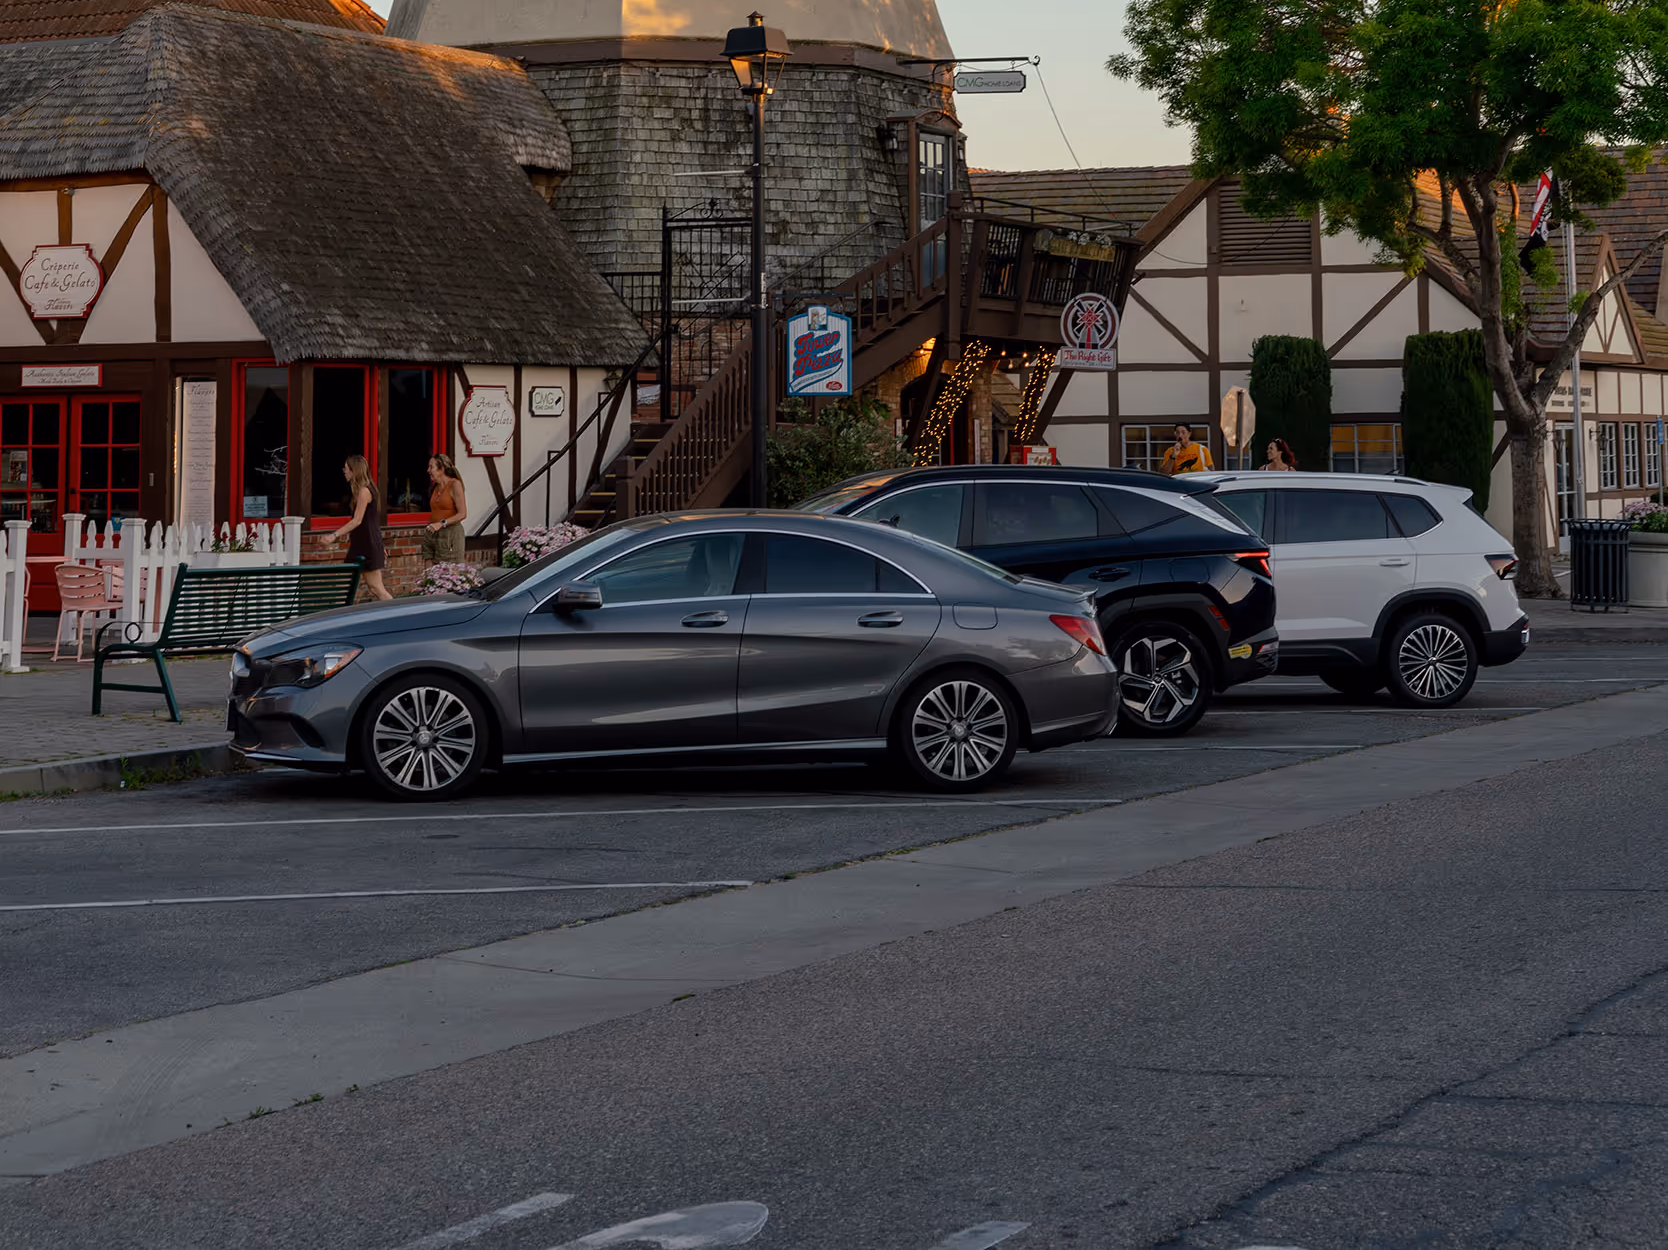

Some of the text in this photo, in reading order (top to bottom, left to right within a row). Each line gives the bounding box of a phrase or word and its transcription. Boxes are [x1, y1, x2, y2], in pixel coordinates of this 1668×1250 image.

[50, 277, 59, 288] &
[797, 332, 840, 355] Tower
[795, 351, 842, 377] Pizza
[534, 392, 554, 405] CMG
